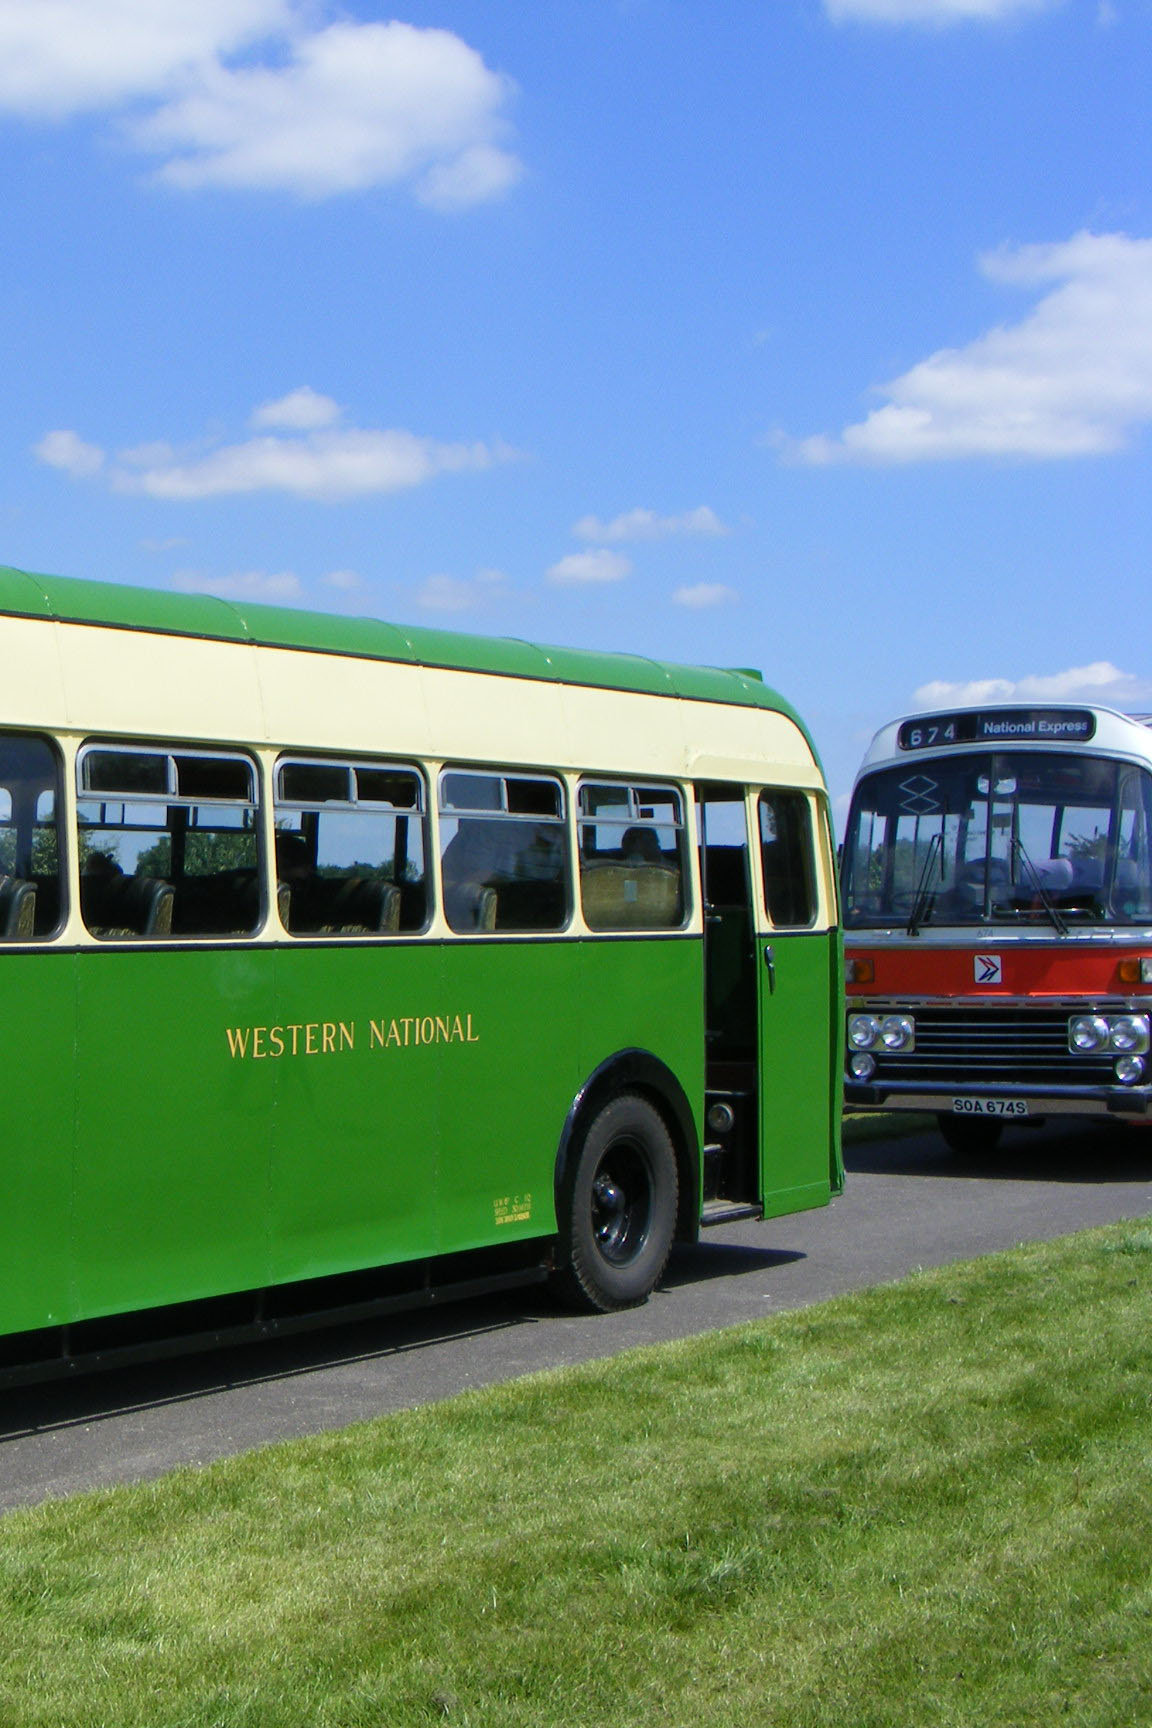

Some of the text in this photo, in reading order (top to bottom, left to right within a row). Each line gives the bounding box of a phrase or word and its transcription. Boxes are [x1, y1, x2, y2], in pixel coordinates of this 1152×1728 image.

[910, 720, 1087, 745] 674 National Express
[226, 1013, 480, 1059] WESTERN NATIONAL
[954, 1099, 1026, 1114] SOA 674S
